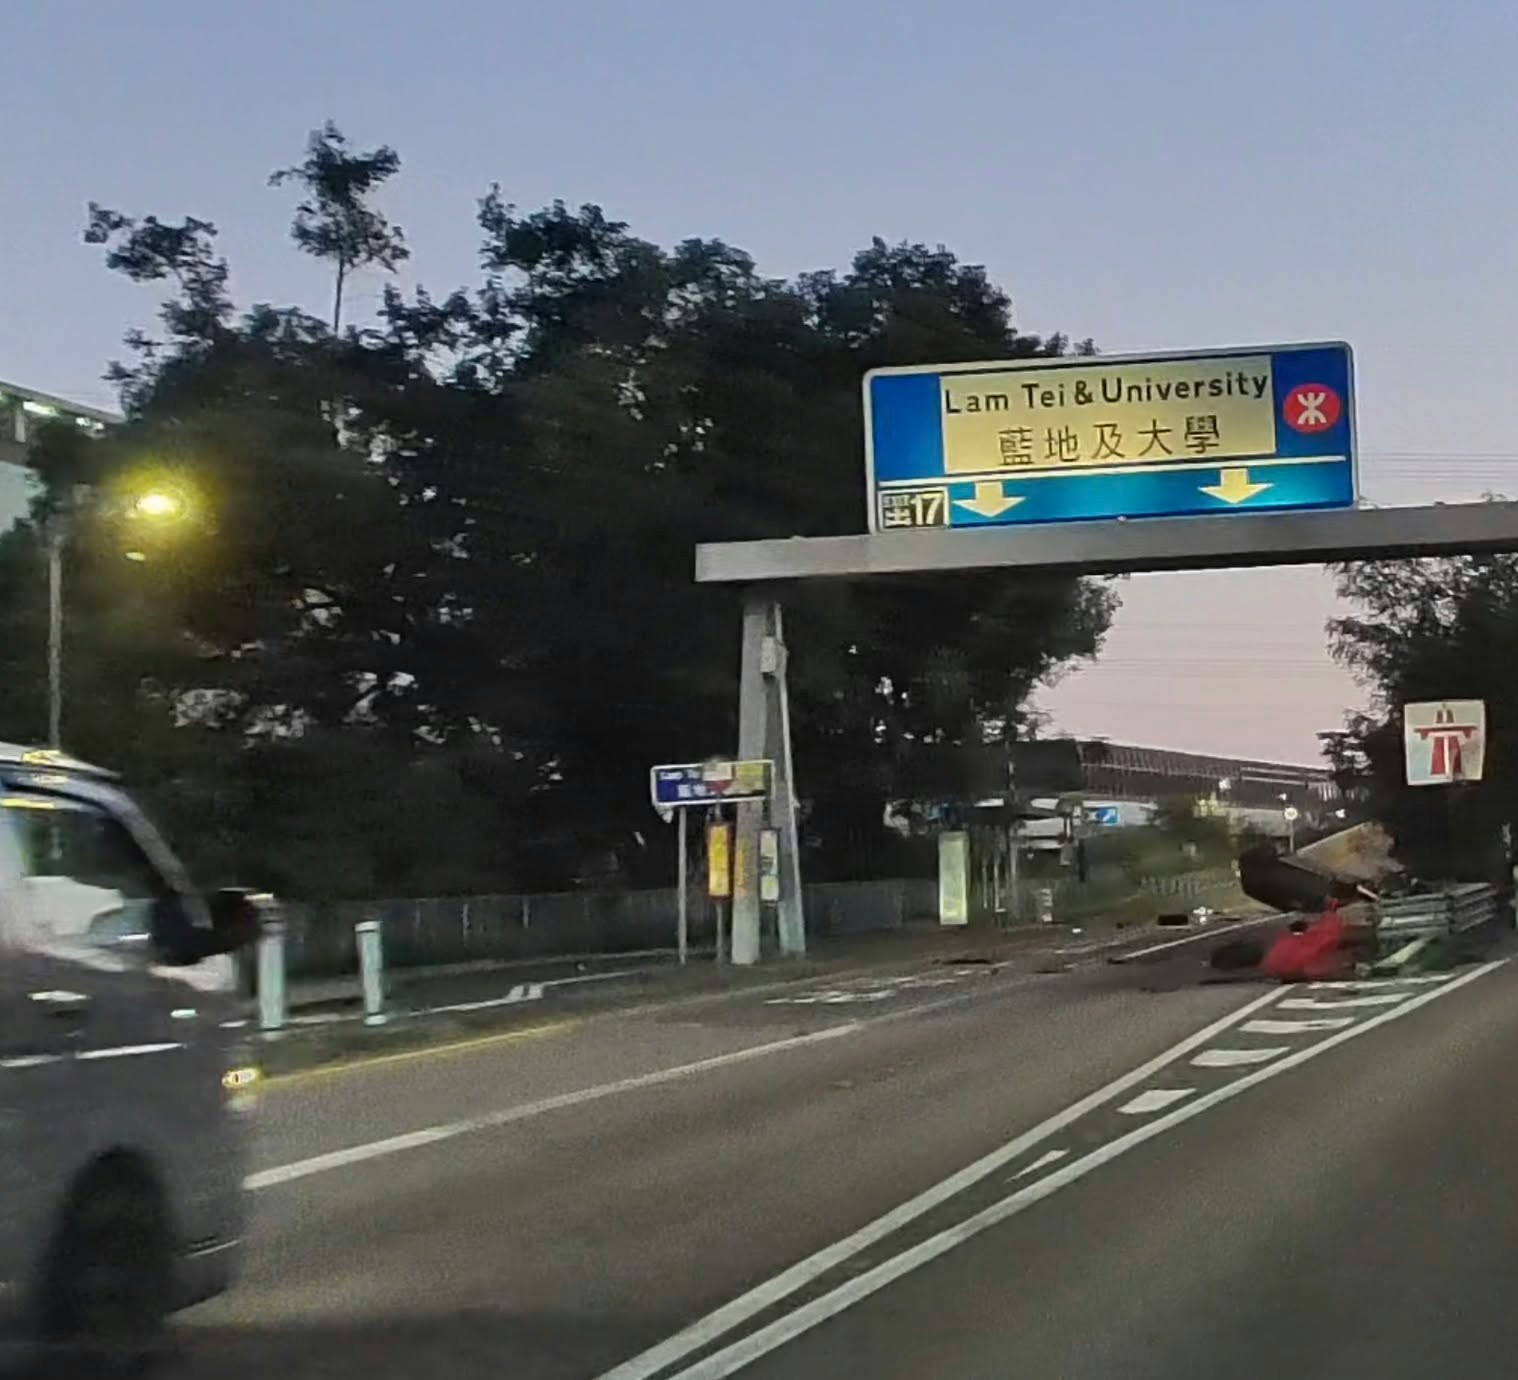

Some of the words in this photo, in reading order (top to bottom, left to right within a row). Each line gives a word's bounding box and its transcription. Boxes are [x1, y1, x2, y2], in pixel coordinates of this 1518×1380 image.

[946, 389, 1009, 414] Lam
[1021, 382, 1065, 409] Tei
[1075, 380, 1094, 405] &
[1101, 371, 1268, 404] University
[998, 414, 1220, 467] 藍地及大學
[910, 493, 944, 525] 17
